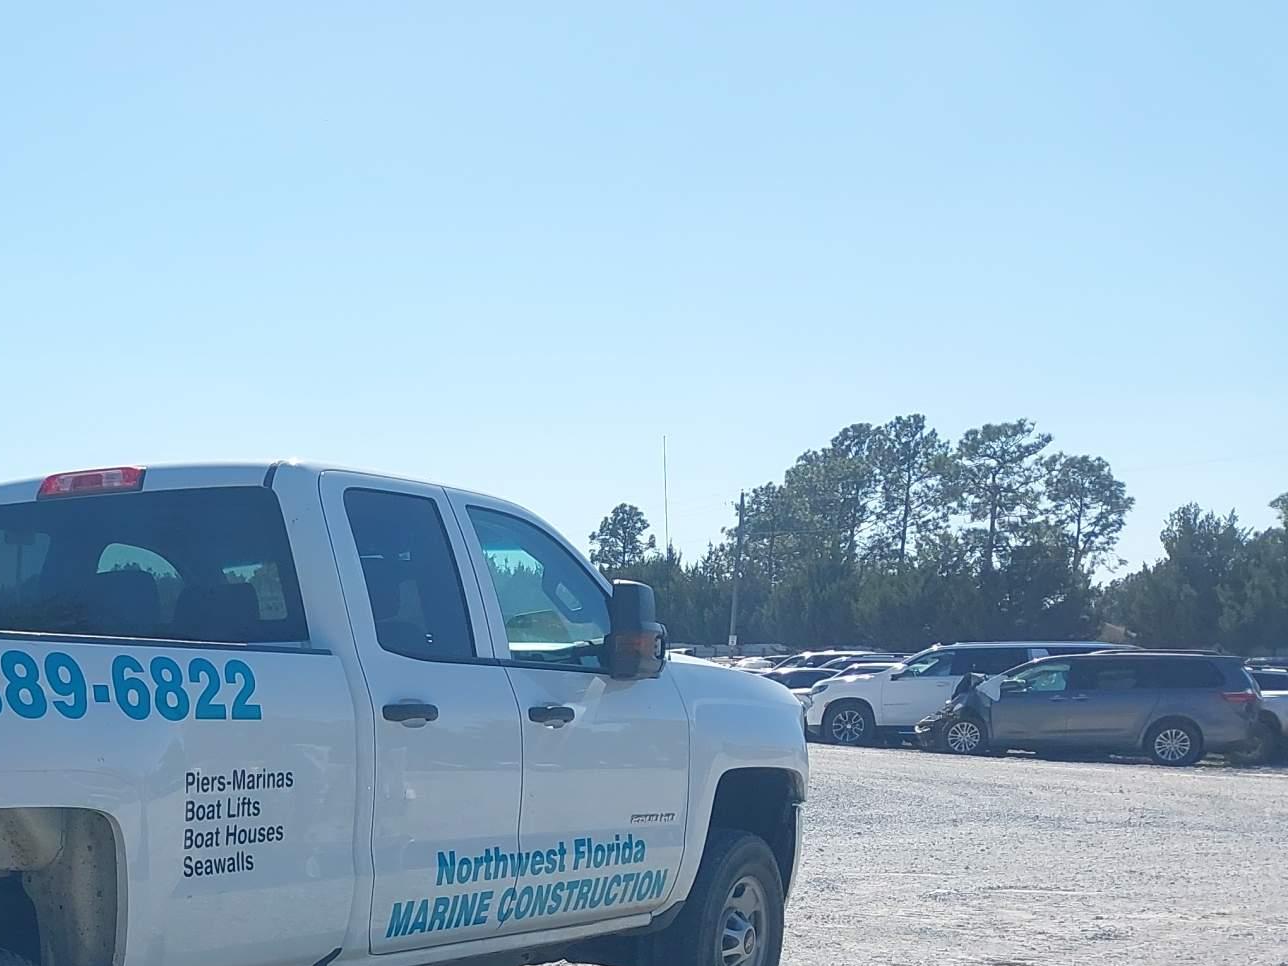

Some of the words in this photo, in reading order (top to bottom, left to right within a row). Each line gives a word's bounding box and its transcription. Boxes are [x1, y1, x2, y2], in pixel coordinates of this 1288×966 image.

[185, 769, 294, 794] Piers-Marinas
[185, 799, 222, 822] Boat
[227, 797, 261, 818] Lifts
[184, 827, 220, 849] Boat
[225, 824, 284, 846] Houses
[183, 851, 254, 878] Seawalls
[436, 840, 567, 886] Northwest
[573, 833, 646, 870] Florida
[385, 890, 494, 938] MARINE
[497, 869, 669, 921] CONSTRUCTION
